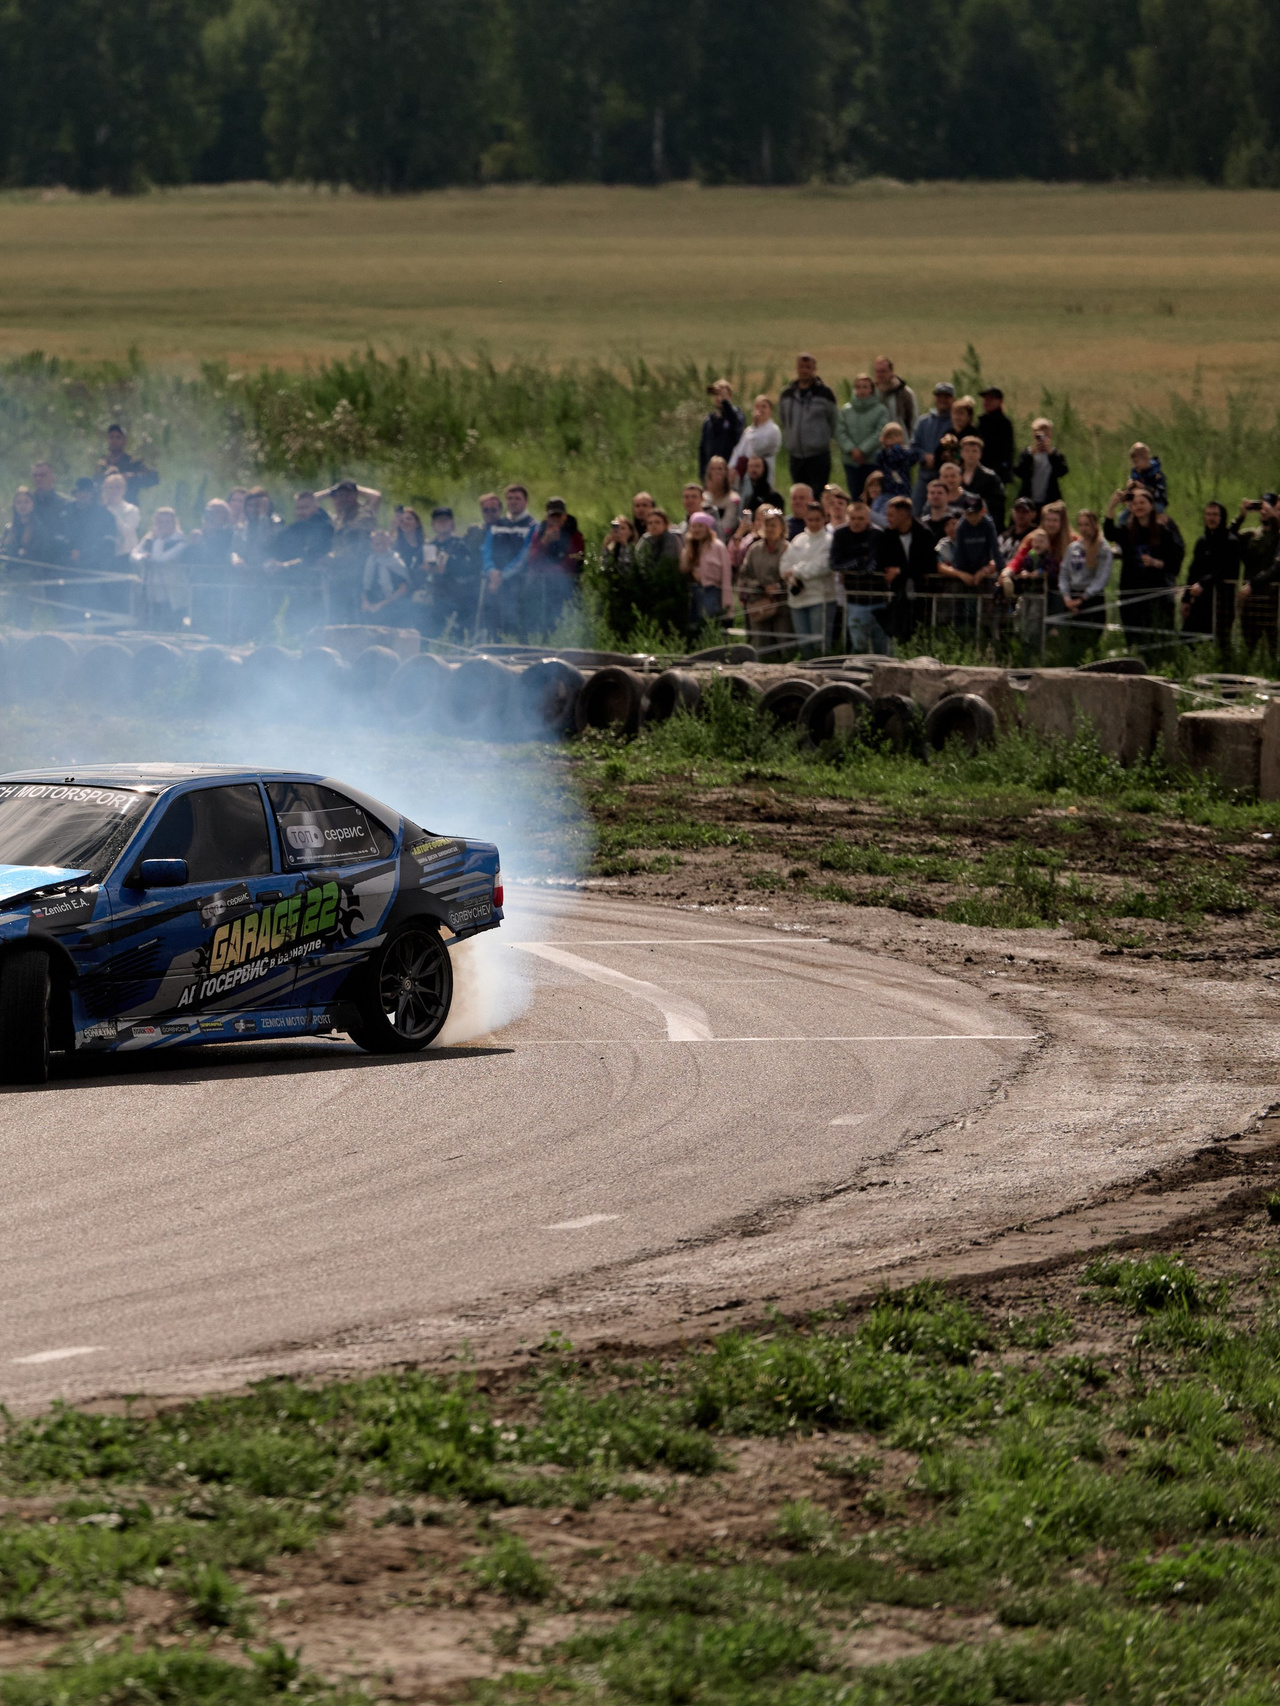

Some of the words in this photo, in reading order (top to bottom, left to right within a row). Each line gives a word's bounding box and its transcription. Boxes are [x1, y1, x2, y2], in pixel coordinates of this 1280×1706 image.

[14, 785, 140, 815] MOTORSPORT
[291, 830, 314, 844] ТОП
[324, 826, 365, 842] сервис
[42, 902, 72, 916] Zenich
[71, 898, 90, 910] E.A.
[209, 893, 303, 975] GARAGE
[300, 881, 339, 937] 22
[261, 1016, 285, 1028] ZENICH
[286, 1014, 331, 1027] MOTOPORT
